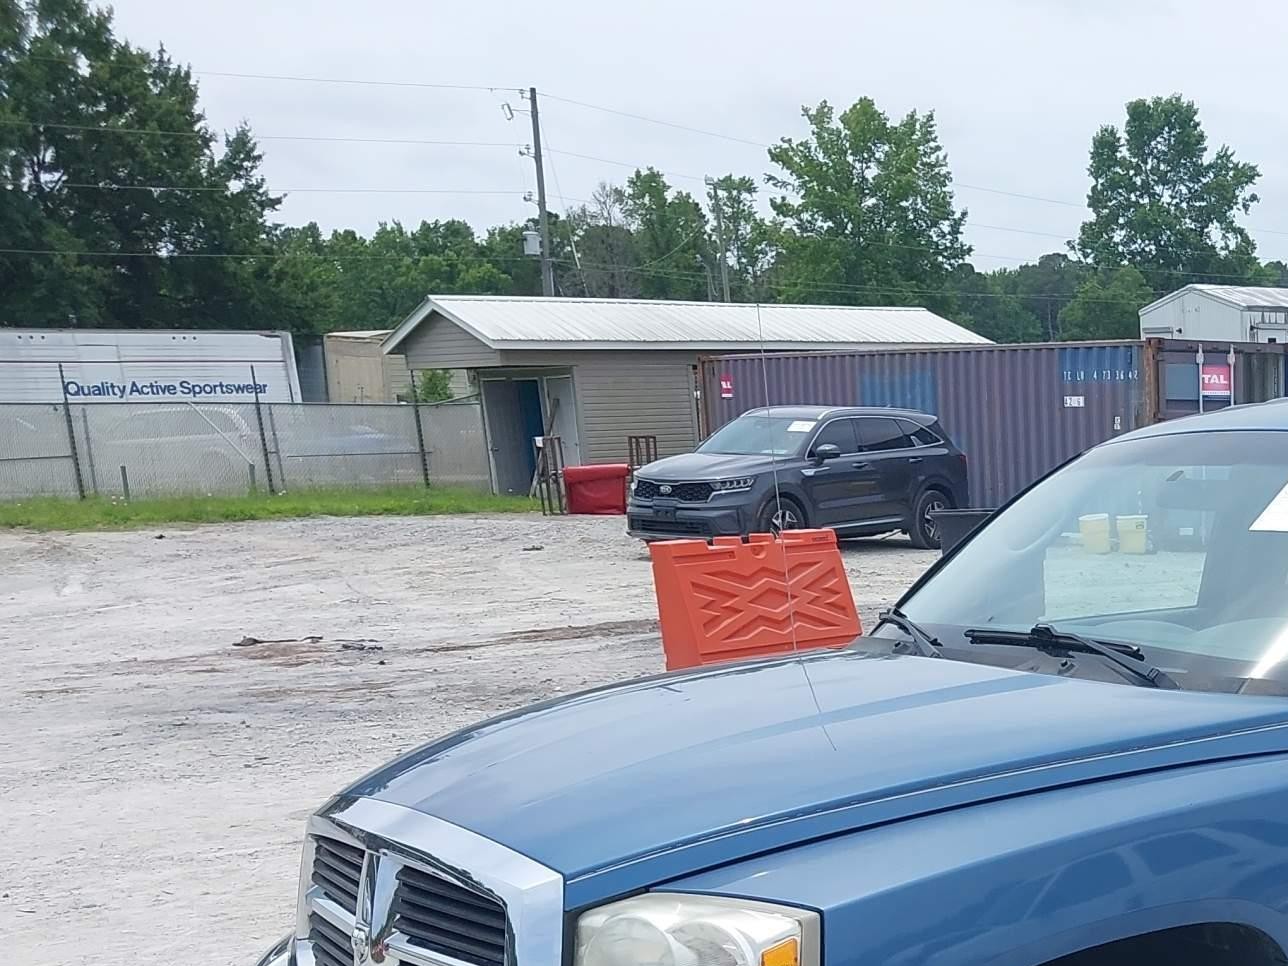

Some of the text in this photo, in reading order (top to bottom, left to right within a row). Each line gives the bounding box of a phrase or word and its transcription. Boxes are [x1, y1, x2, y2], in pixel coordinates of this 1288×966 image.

[1202, 374, 1229, 384] TAL
[65, 380, 268, 399] Quality Active Sportswear
